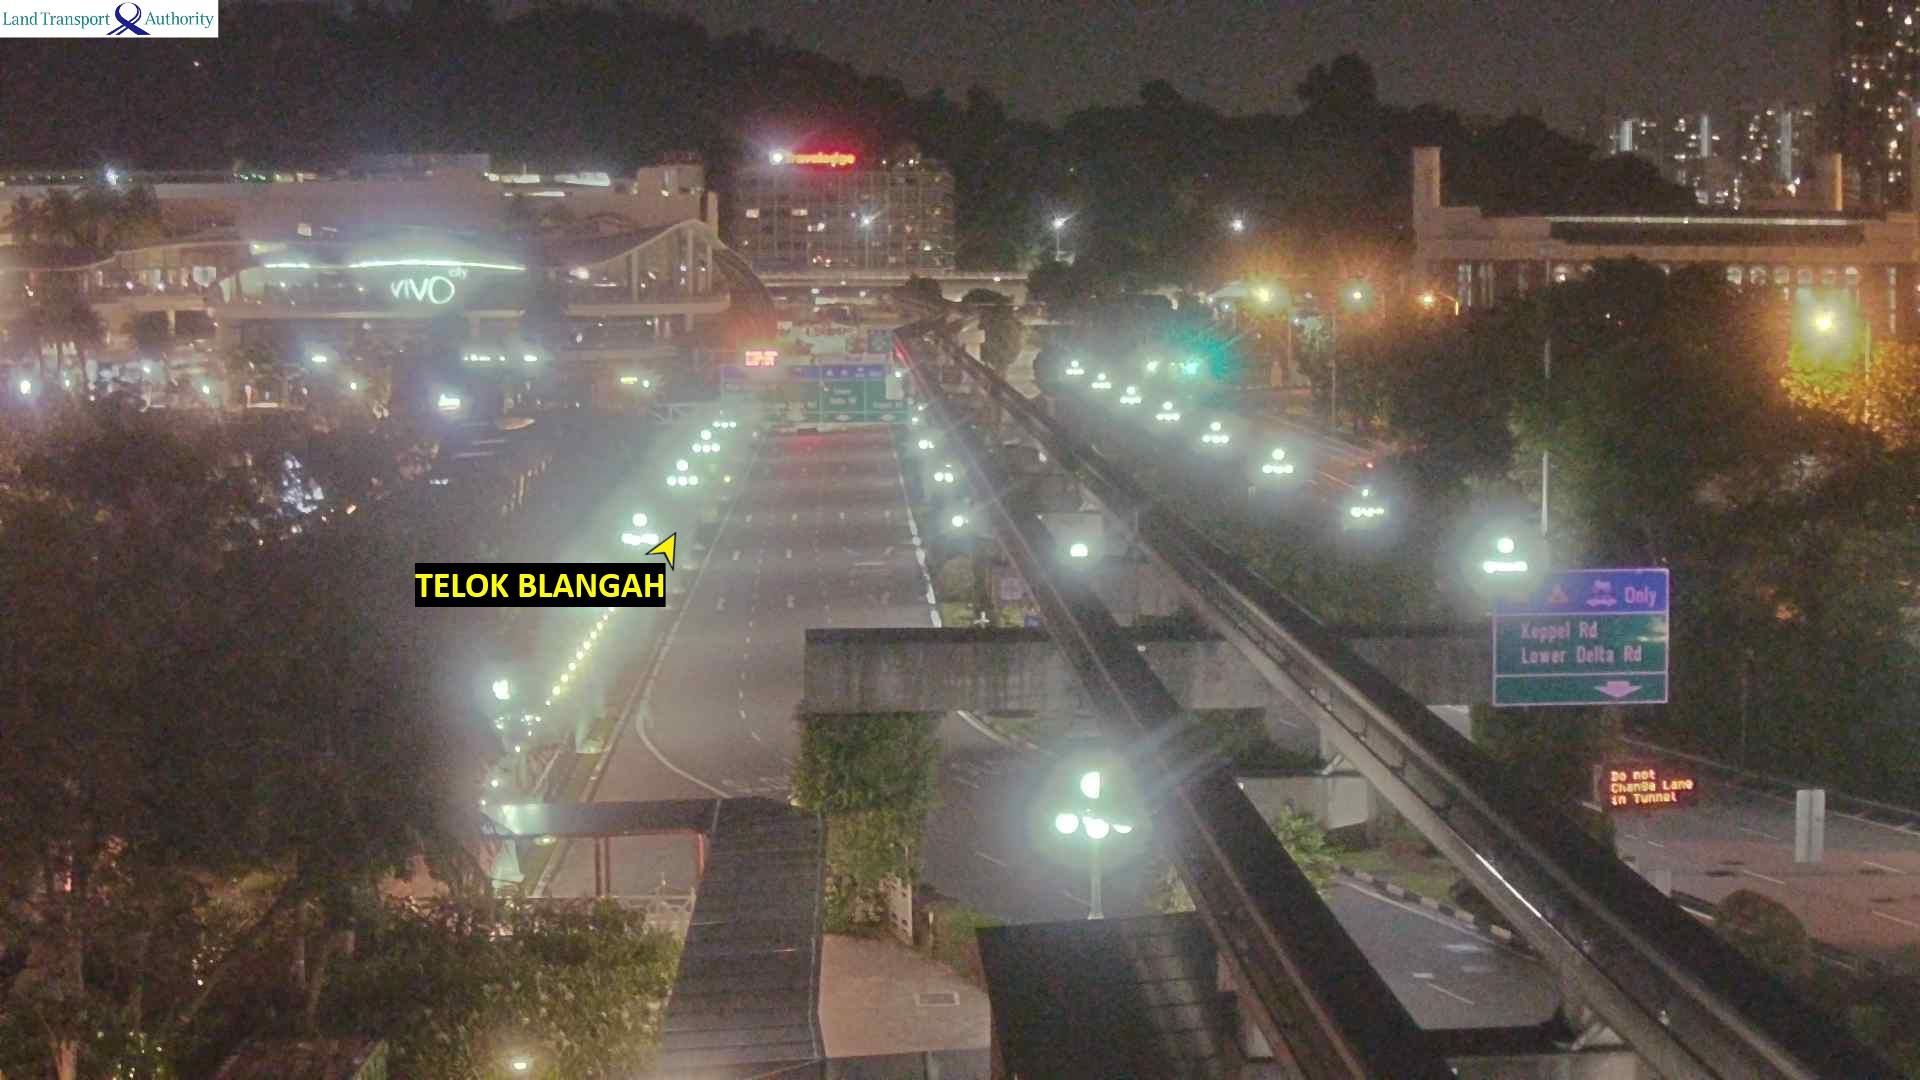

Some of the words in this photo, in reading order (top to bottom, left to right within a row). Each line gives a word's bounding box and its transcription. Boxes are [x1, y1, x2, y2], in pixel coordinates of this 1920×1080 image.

[1624, 586, 1657, 608] Only
[1520, 622, 1571, 643] Keppel
[1579, 621, 1598, 639] Rd
[1521, 647, 1567, 664] Lower
[1576, 645, 1615, 664] Delta
[1623, 644, 1642, 662] Rd
[1610, 771, 1627, 782] Do
[1632, 769, 1656, 780] not
[1662, 778, 1694, 791] Lane
[1611, 794, 1627, 806] in
[1633, 791, 1678, 804] Tunnel
